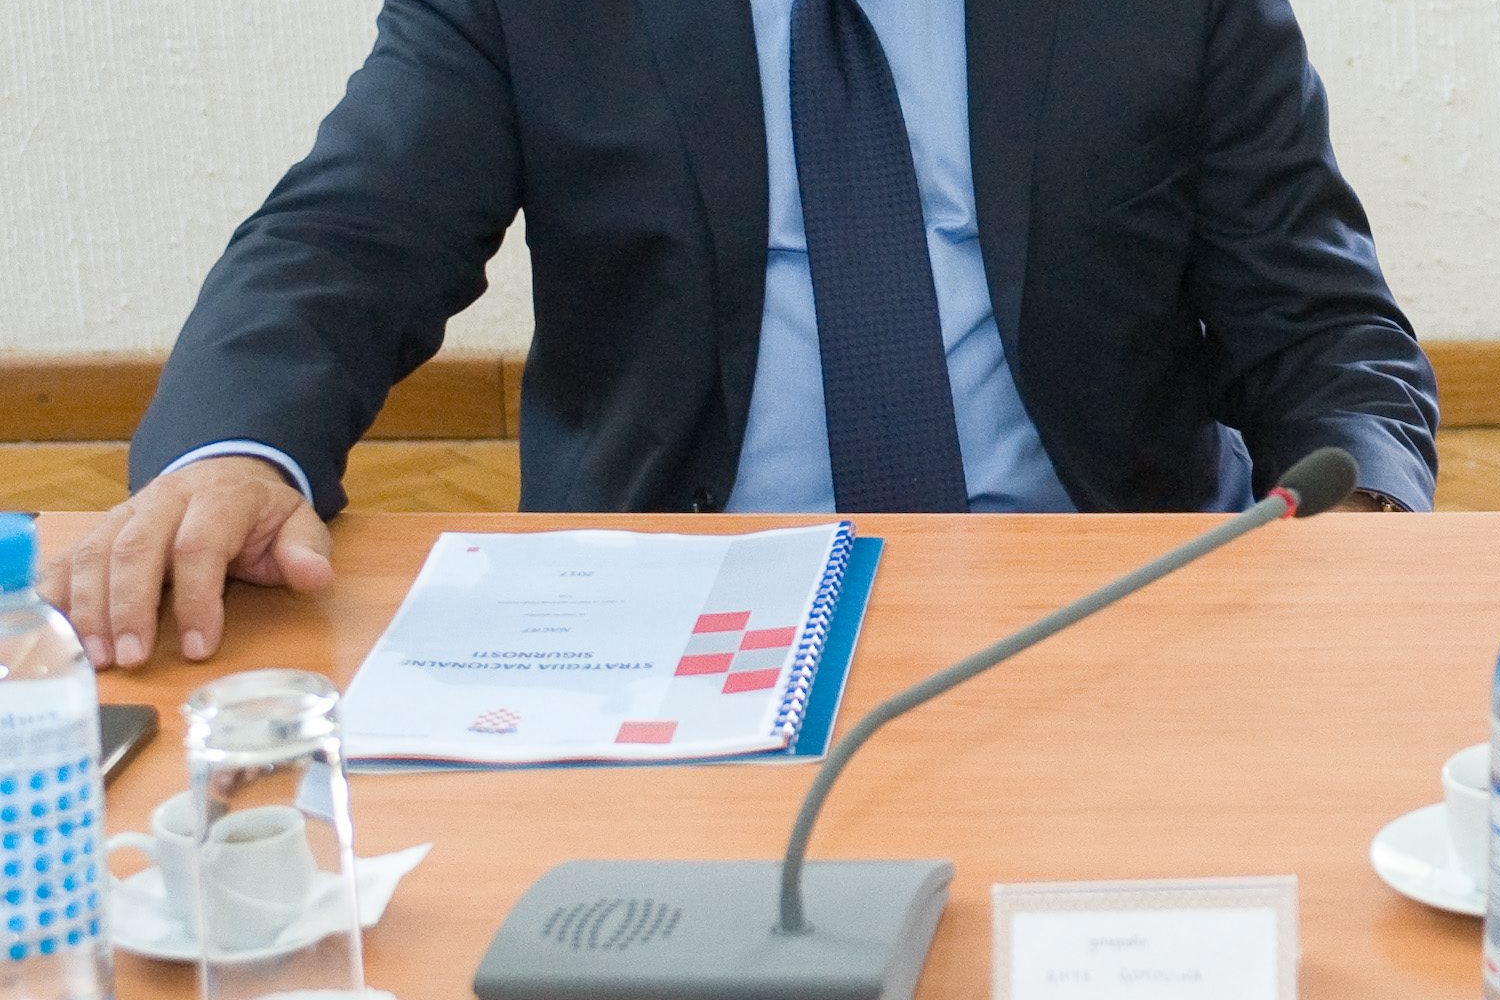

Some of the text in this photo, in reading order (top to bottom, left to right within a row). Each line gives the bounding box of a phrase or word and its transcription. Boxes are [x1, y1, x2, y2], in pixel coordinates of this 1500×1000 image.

[472, 651, 595, 659] SIGURNOSTI
[401, 658, 654, 670] STRATEGIJA NACIONALNE
